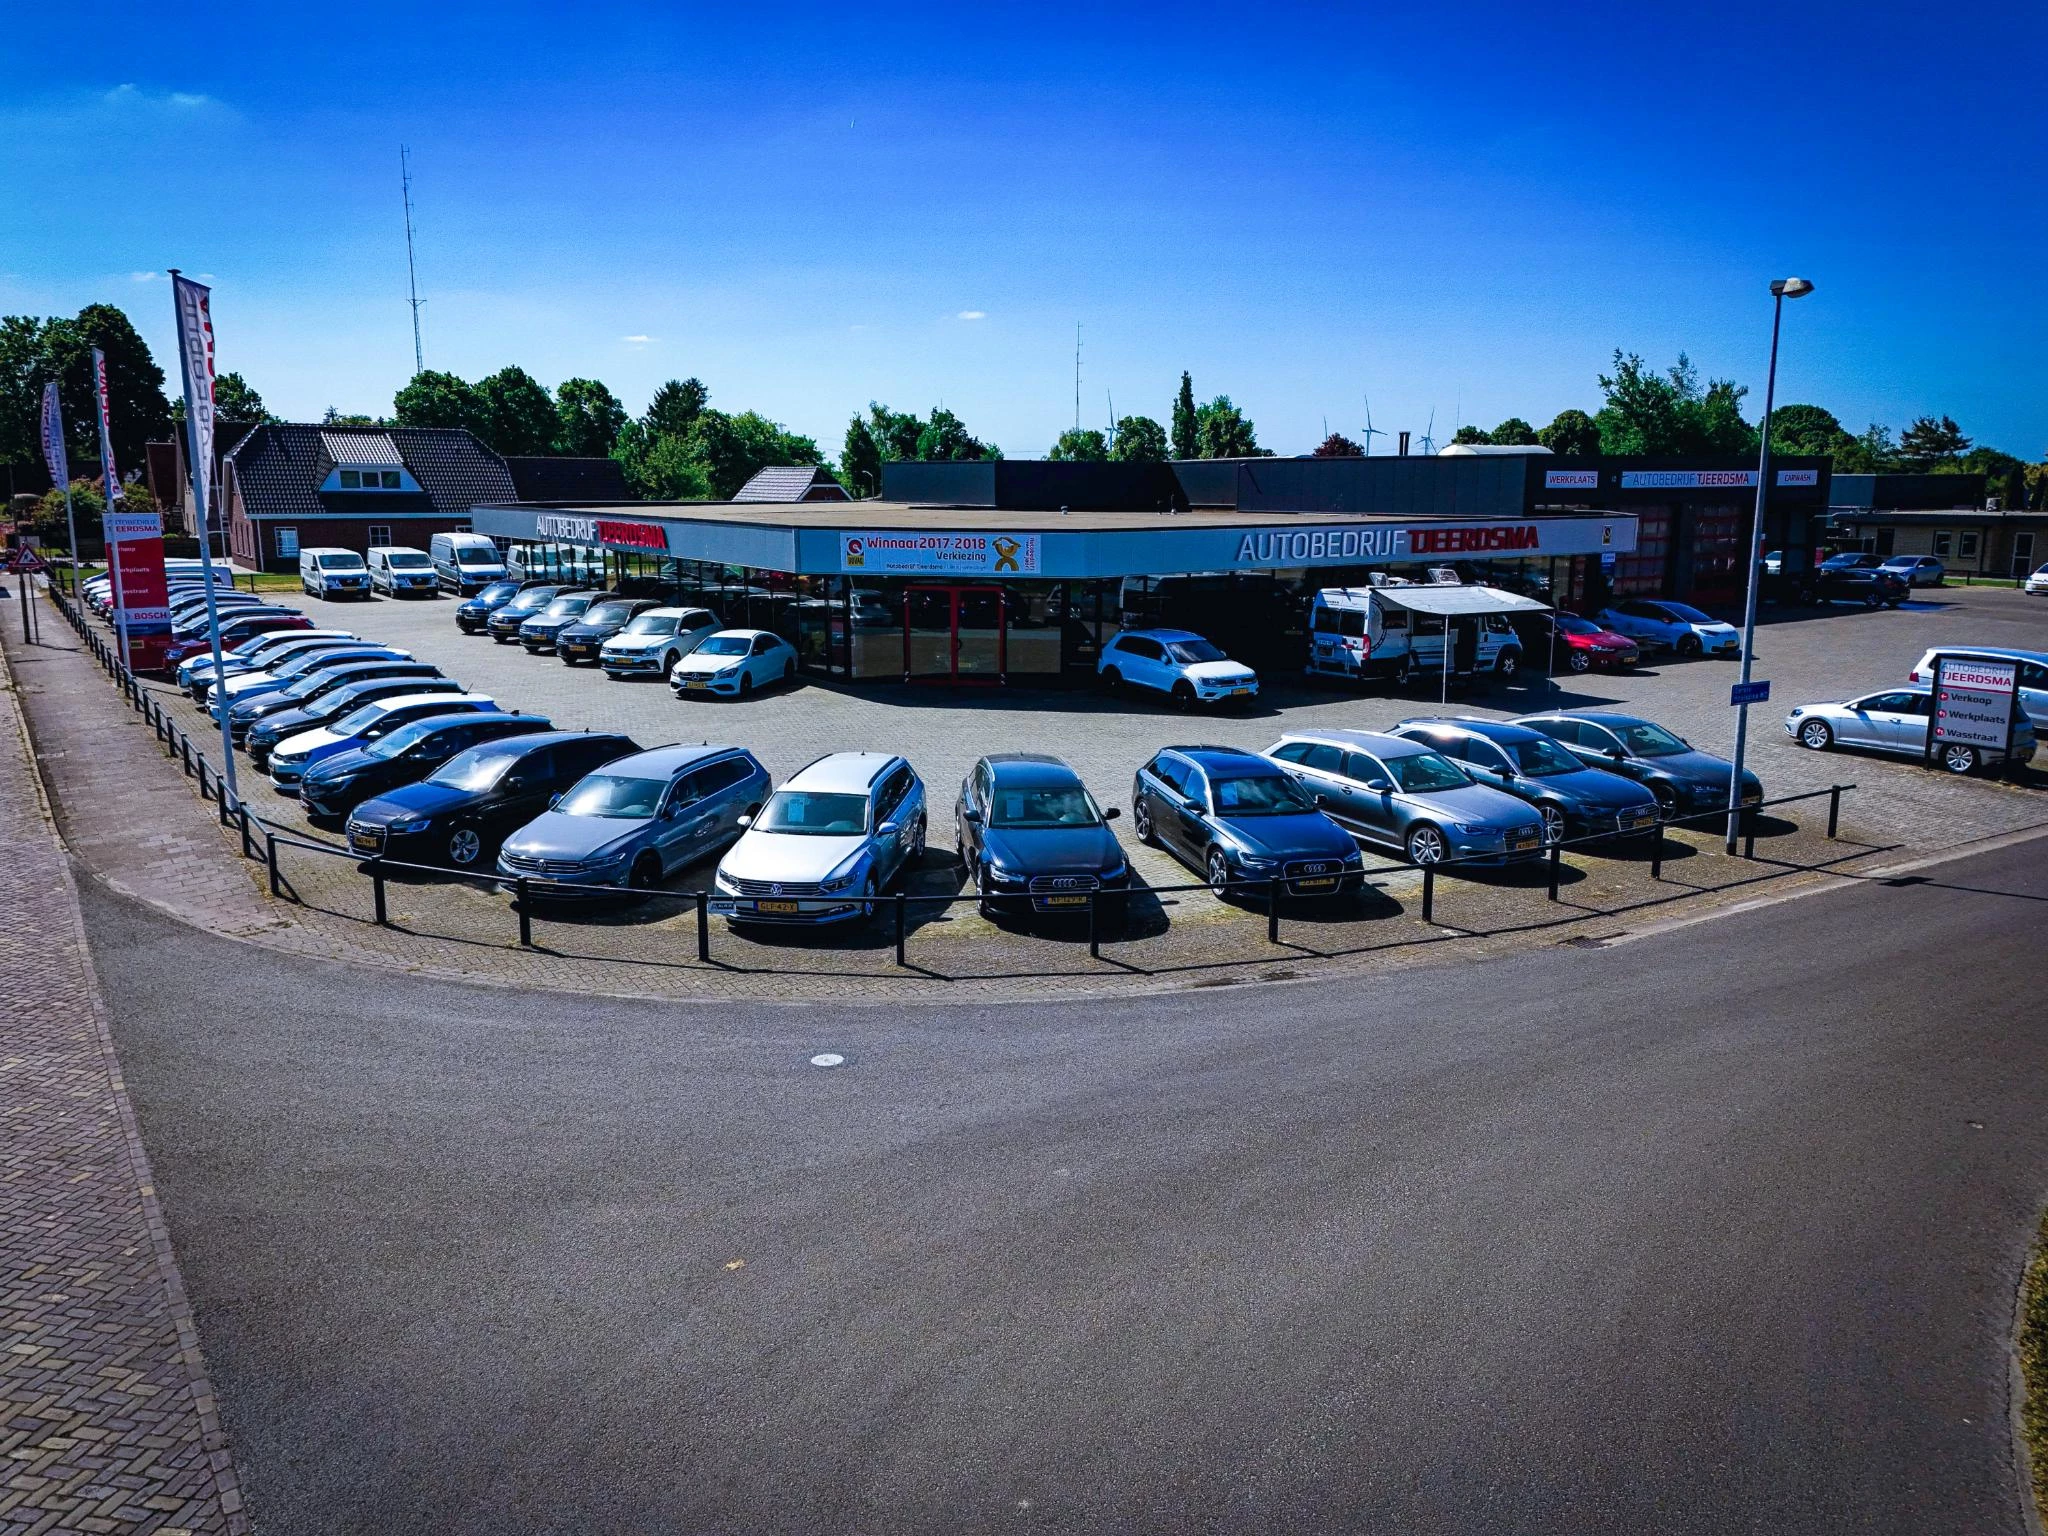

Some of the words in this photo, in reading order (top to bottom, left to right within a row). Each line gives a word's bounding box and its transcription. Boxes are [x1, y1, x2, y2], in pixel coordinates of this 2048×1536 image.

[1550, 475, 1595, 484] WERKPLAATS
[1633, 473, 1694, 486] AUTOBEDRIJF
[1697, 473, 1749, 485] TJEERDSMA
[1785, 474, 1811, 482] CARWASH
[536, 515, 596, 541] AUTOBEDRIJF
[866, 536, 918, 549] Winnaar
[919, 537, 986, 550] 2017-2018
[1236, 529, 1407, 562] AUTOBEDRIJF
[1407, 526, 1539, 554] TJEERDSMA
[936, 551, 986, 563] Verkiezing
[134, 612, 167, 620] BOSCH
[1942, 663, 2013, 676] AUTOBEDRIJF
[1941, 671, 2012, 687] TJEERDSMA
[1951, 693, 1992, 707] Verkoop
[1949, 710, 2006, 725] Werkplaats
[1947, 728, 1998, 742] Wasstraat
